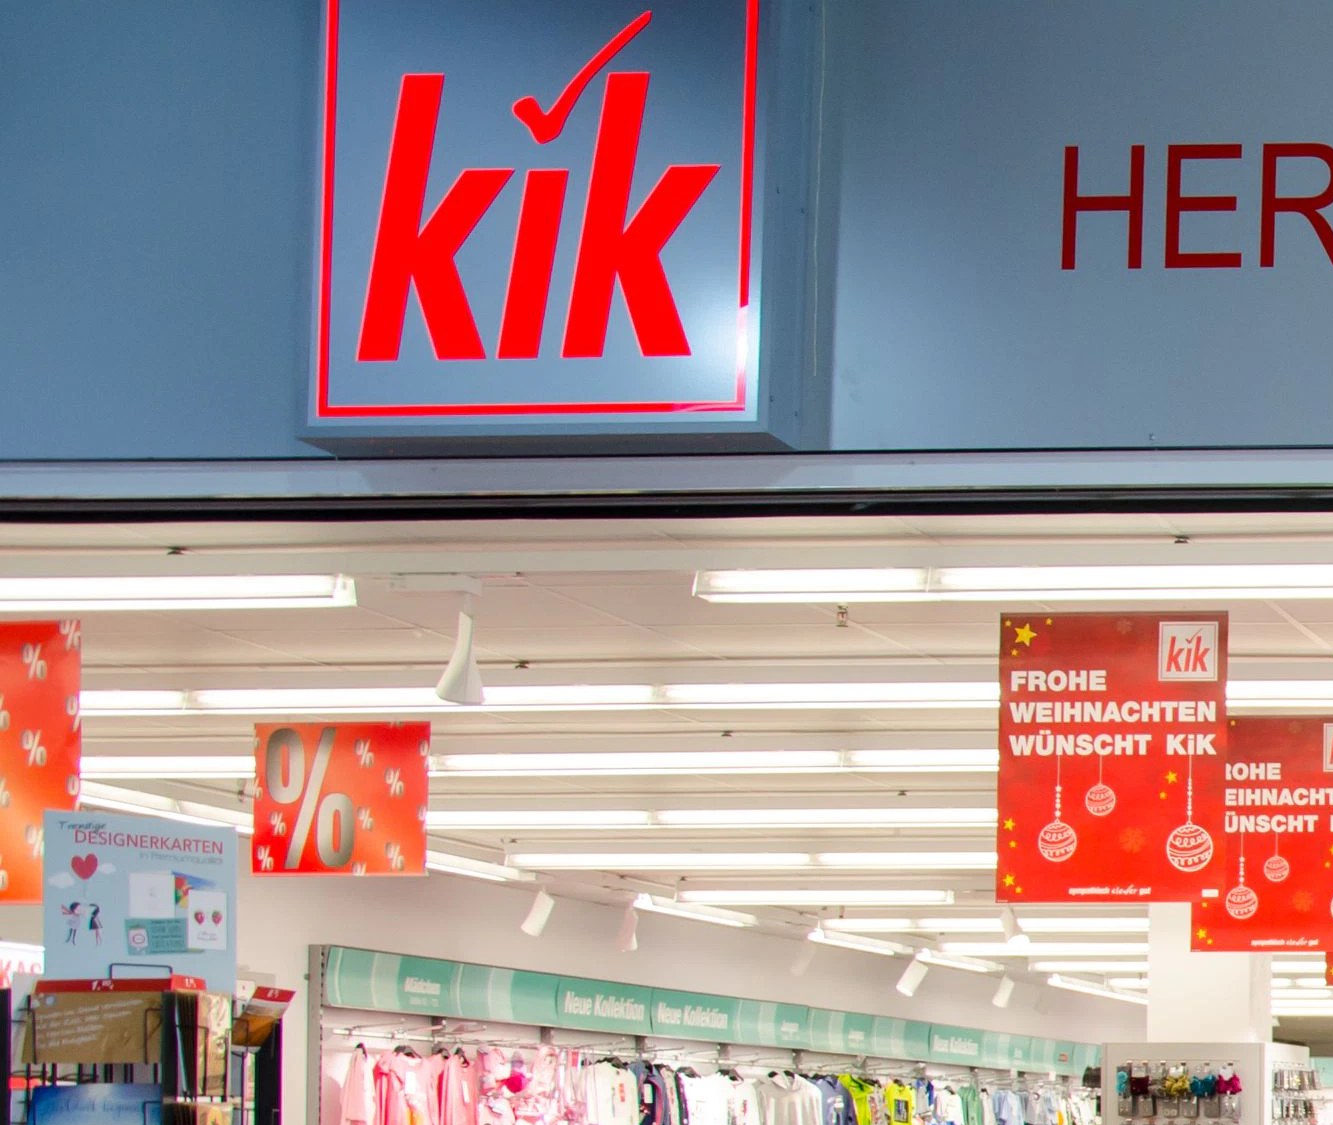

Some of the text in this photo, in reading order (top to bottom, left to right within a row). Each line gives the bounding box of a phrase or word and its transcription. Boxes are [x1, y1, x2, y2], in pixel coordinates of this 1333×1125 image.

[356, 10, 721, 362] kik
[1010, 670, 1107, 692] FROHE
[1009, 701, 1217, 723] WEIHNACHTEN
[1008, 729, 1152, 756] WÜNSCHT
[74, 829, 224, 855] DESIGNERKARTEN
[564, 991, 645, 1021] Neue Kollektion
[657, 1002, 729, 1030] Neue Kollektion
